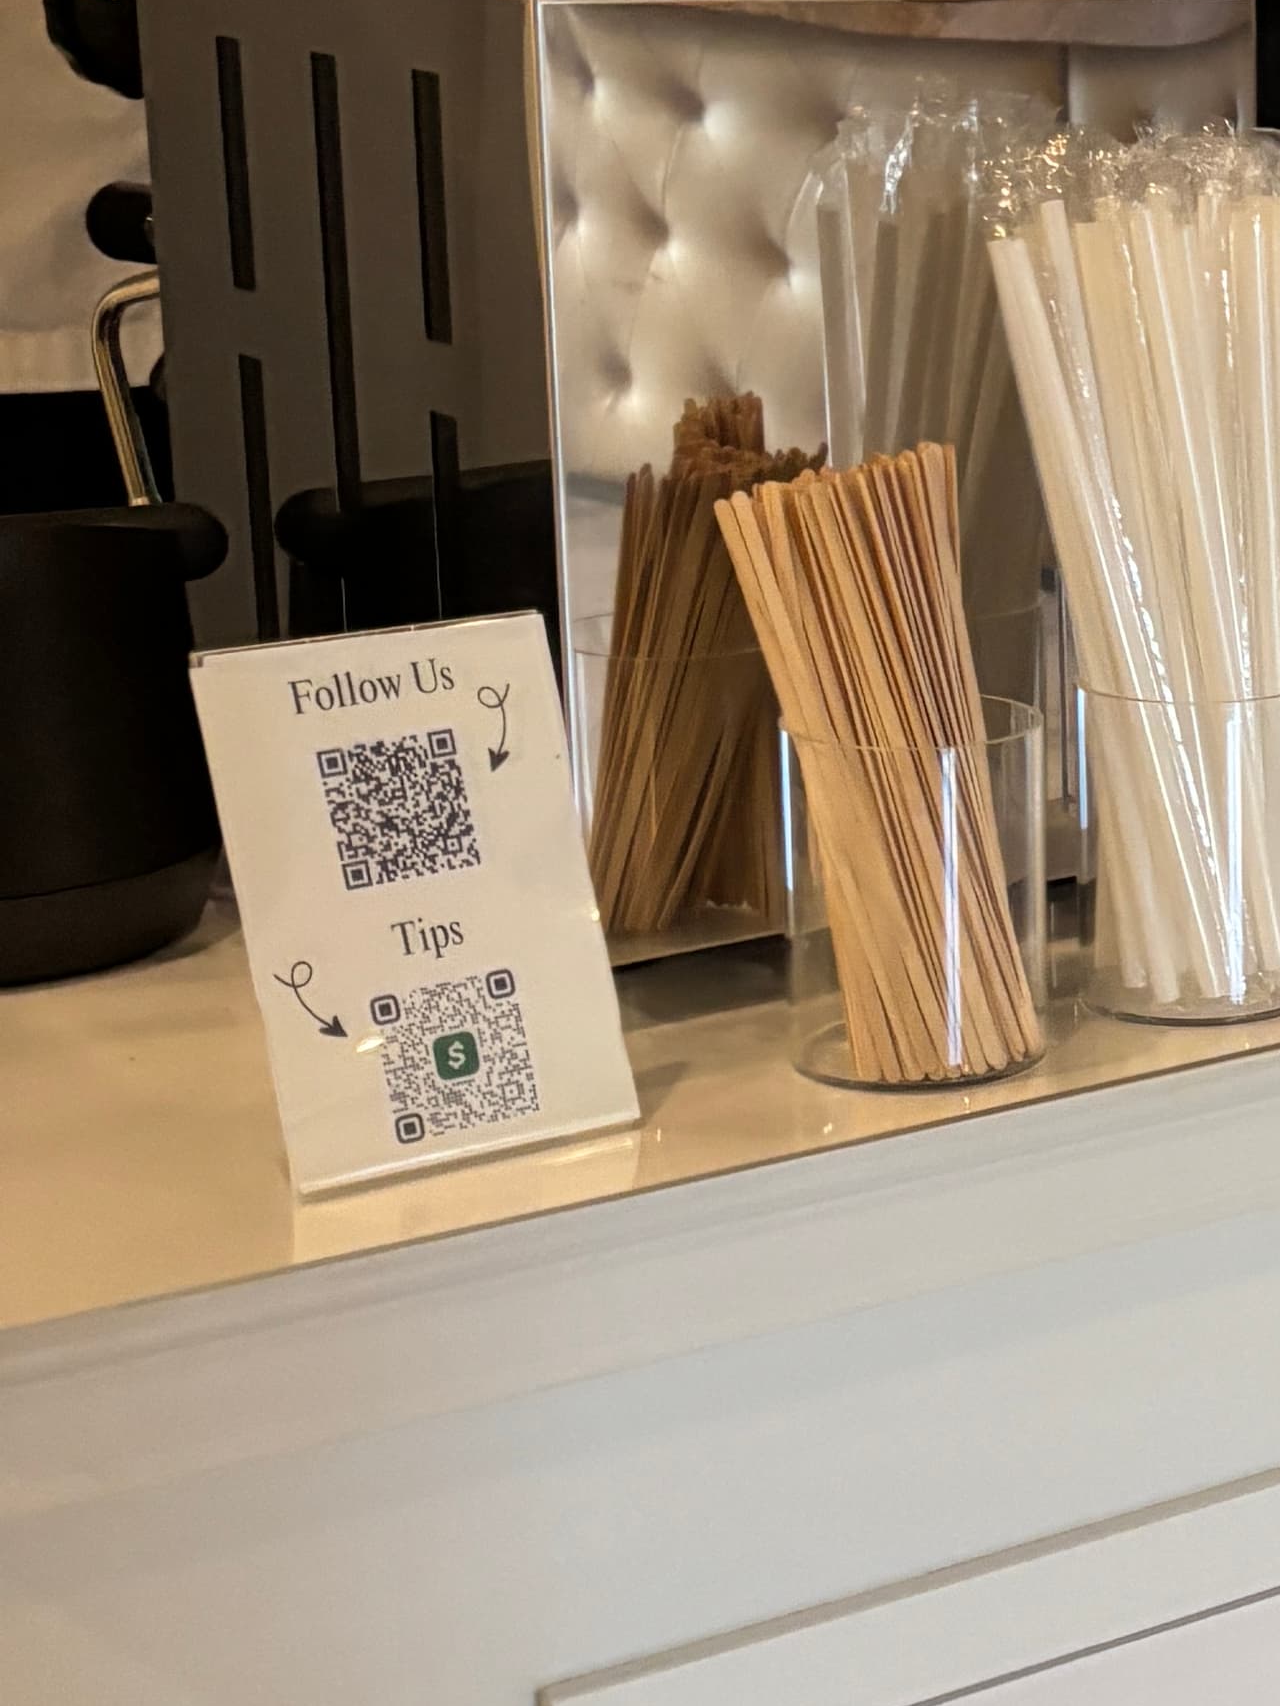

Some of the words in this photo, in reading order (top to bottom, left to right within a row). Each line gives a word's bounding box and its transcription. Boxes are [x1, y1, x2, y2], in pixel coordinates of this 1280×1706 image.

[288, 672, 402, 715] Follow
[409, 657, 456, 694] Us
[390, 914, 465, 959] Tips
